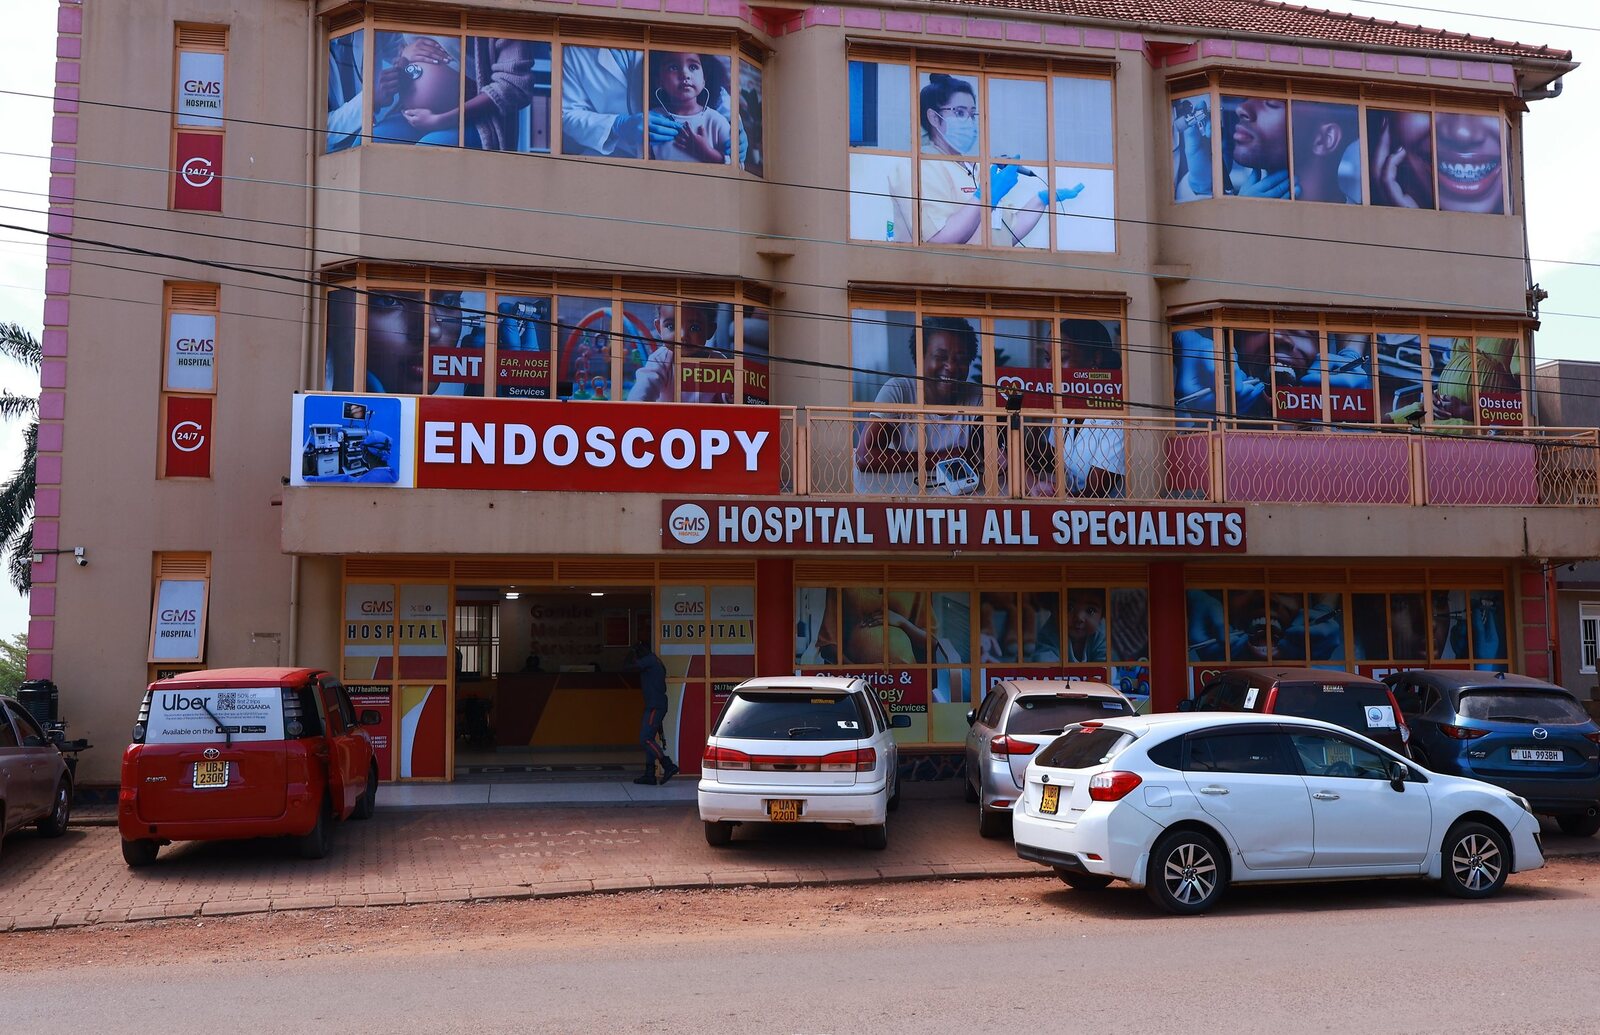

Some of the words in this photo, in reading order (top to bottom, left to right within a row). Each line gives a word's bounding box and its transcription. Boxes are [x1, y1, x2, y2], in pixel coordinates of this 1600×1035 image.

[184, 80, 220, 94] GMS
[186, 99, 217, 108] HOSPITAL
[176, 338, 214, 352] GMS
[178, 358, 211, 366] HOSPITAL
[432, 355, 482, 376] ENT
[524, 360, 549, 368] NOSE
[500, 368, 508, 377] &
[511, 370, 548, 378] THROAT
[682, 367, 766, 389] PEDIATRIC
[509, 387, 544, 396] Services
[1026, 381, 1122, 395] CARDIOLOGY
[1286, 393, 1366, 411] DENTAL
[424, 420, 770, 471] ENDOSCOPY
[672, 516, 705, 531] GMS
[718, 506, 874, 543] HOSPITAL
[886, 508, 968, 544] WITH
[981, 510, 1039, 545] ALL
[1052, 510, 1242, 546] SPECIALISTS
[361, 601, 392, 613] GMS
[674, 602, 704, 613] GMS
[161, 609, 196, 622] GMS
[160, 630, 192, 638] HOSPITAL
[348, 624, 438, 638] HOSPITAL
[663, 624, 746, 638] HOSPITAL
[900, 671, 912, 684] &
[162, 694, 211, 710] Uber
[891, 704, 926, 712] Services
[1522, 750, 1532, 758] UA
[1536, 751, 1558, 760] 993BH
[206, 762, 224, 772] UBJ
[200, 773, 224, 784] 230R
[421, 828, 660, 841] AMBULANCE
